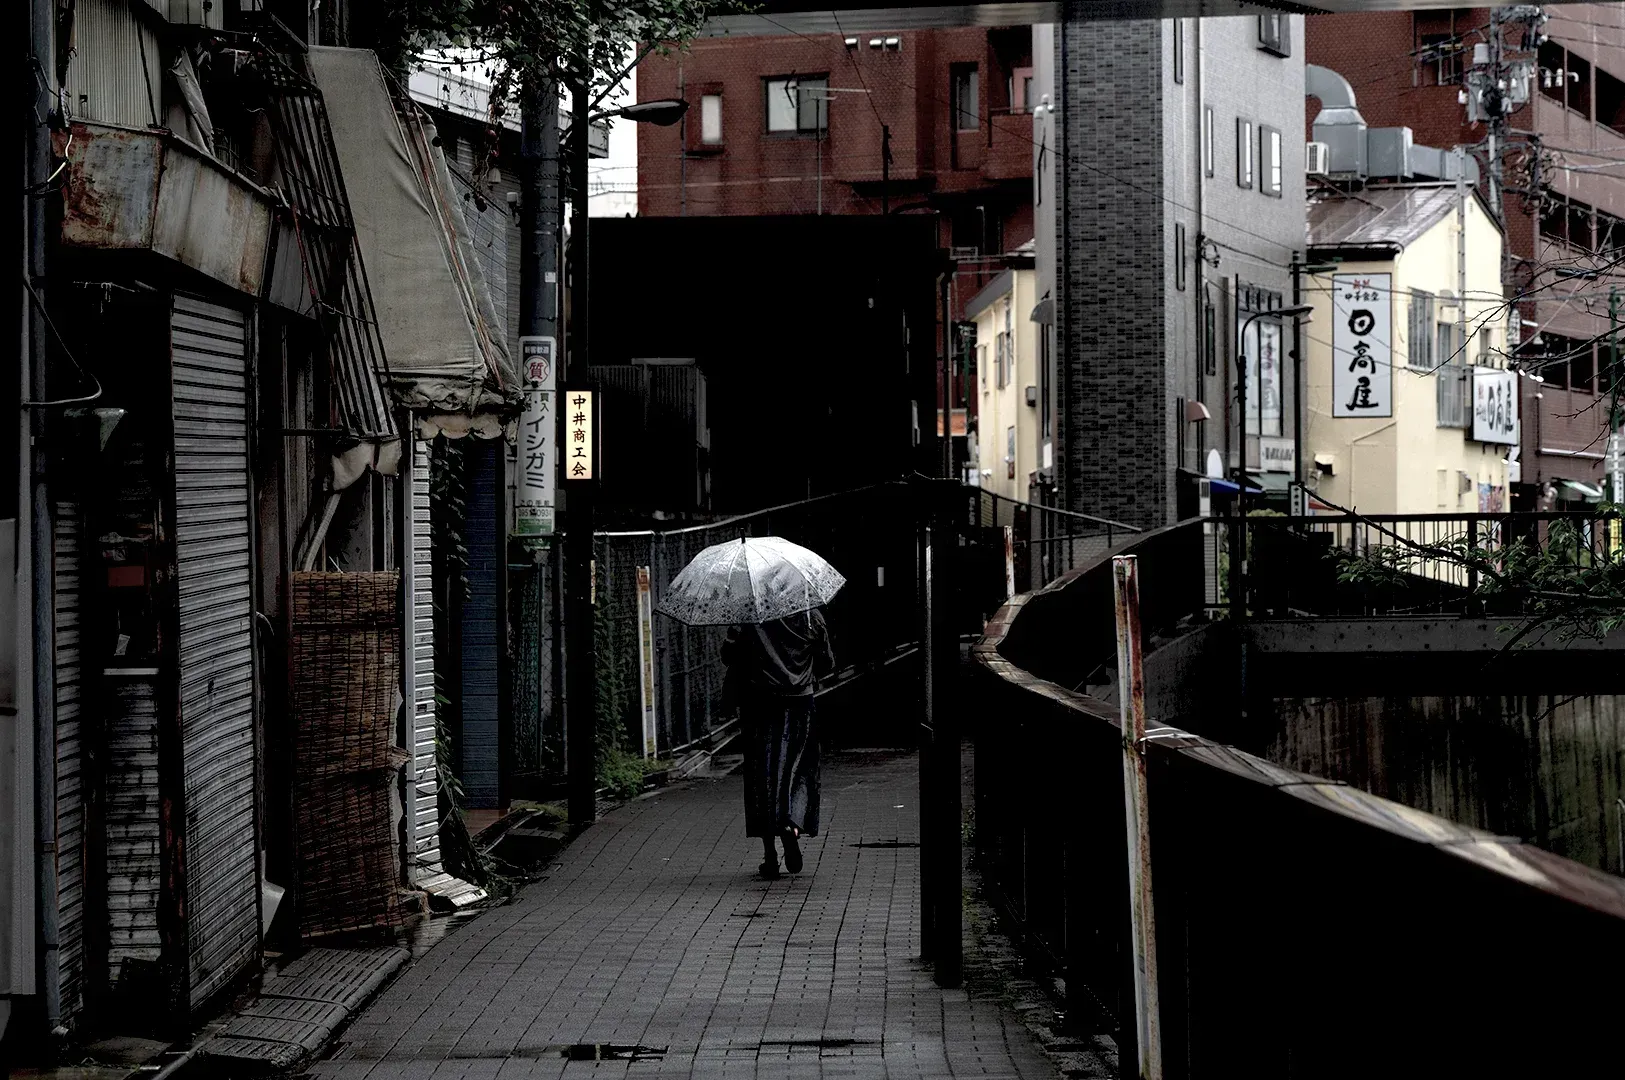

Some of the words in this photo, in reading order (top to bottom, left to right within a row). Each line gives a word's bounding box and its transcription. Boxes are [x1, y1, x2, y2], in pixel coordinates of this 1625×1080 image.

[529, 362, 544, 380] 質
[1345, 309, 1380, 411] 日高屋
[526, 415, 546, 489] イシガミ
[572, 394, 587, 477] 中井商工会
